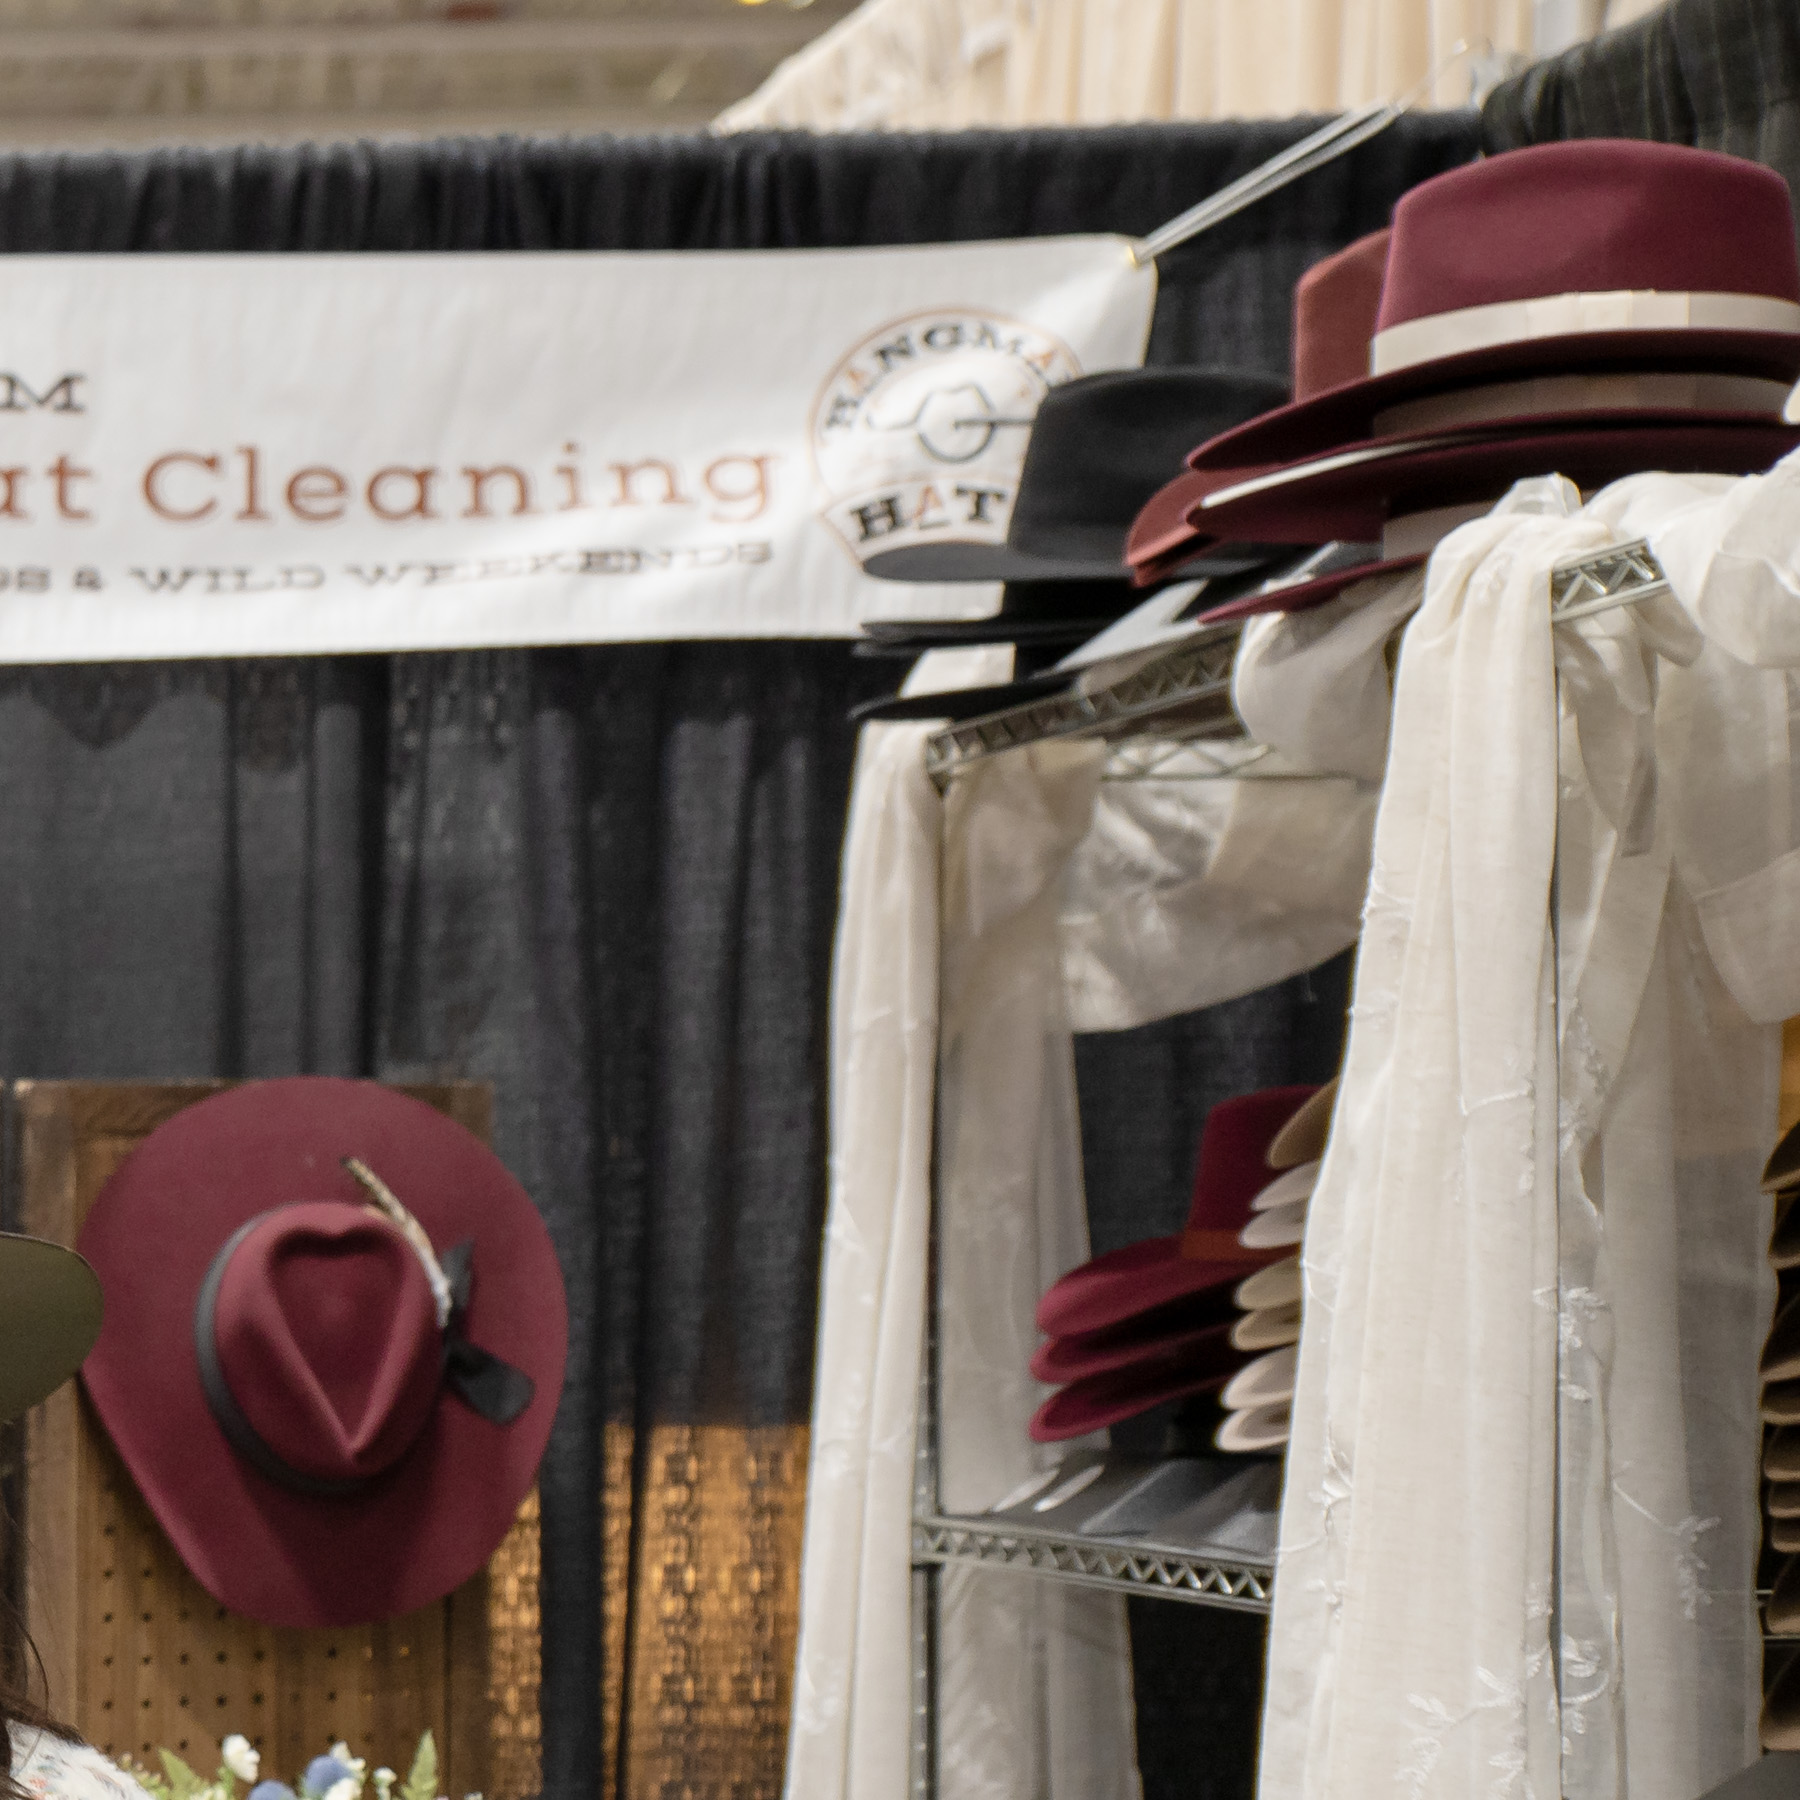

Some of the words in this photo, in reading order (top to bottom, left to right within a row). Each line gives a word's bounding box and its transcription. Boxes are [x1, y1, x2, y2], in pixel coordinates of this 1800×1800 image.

[826, 321, 1072, 430] HANGMA
[139, 441, 773, 524] Cleaning
[849, 484, 1006, 542] HAT
[72, 566, 104, 593] &
[127, 565, 326, 595] WILD
[344, 540, 774, 587] WEEKENDS
